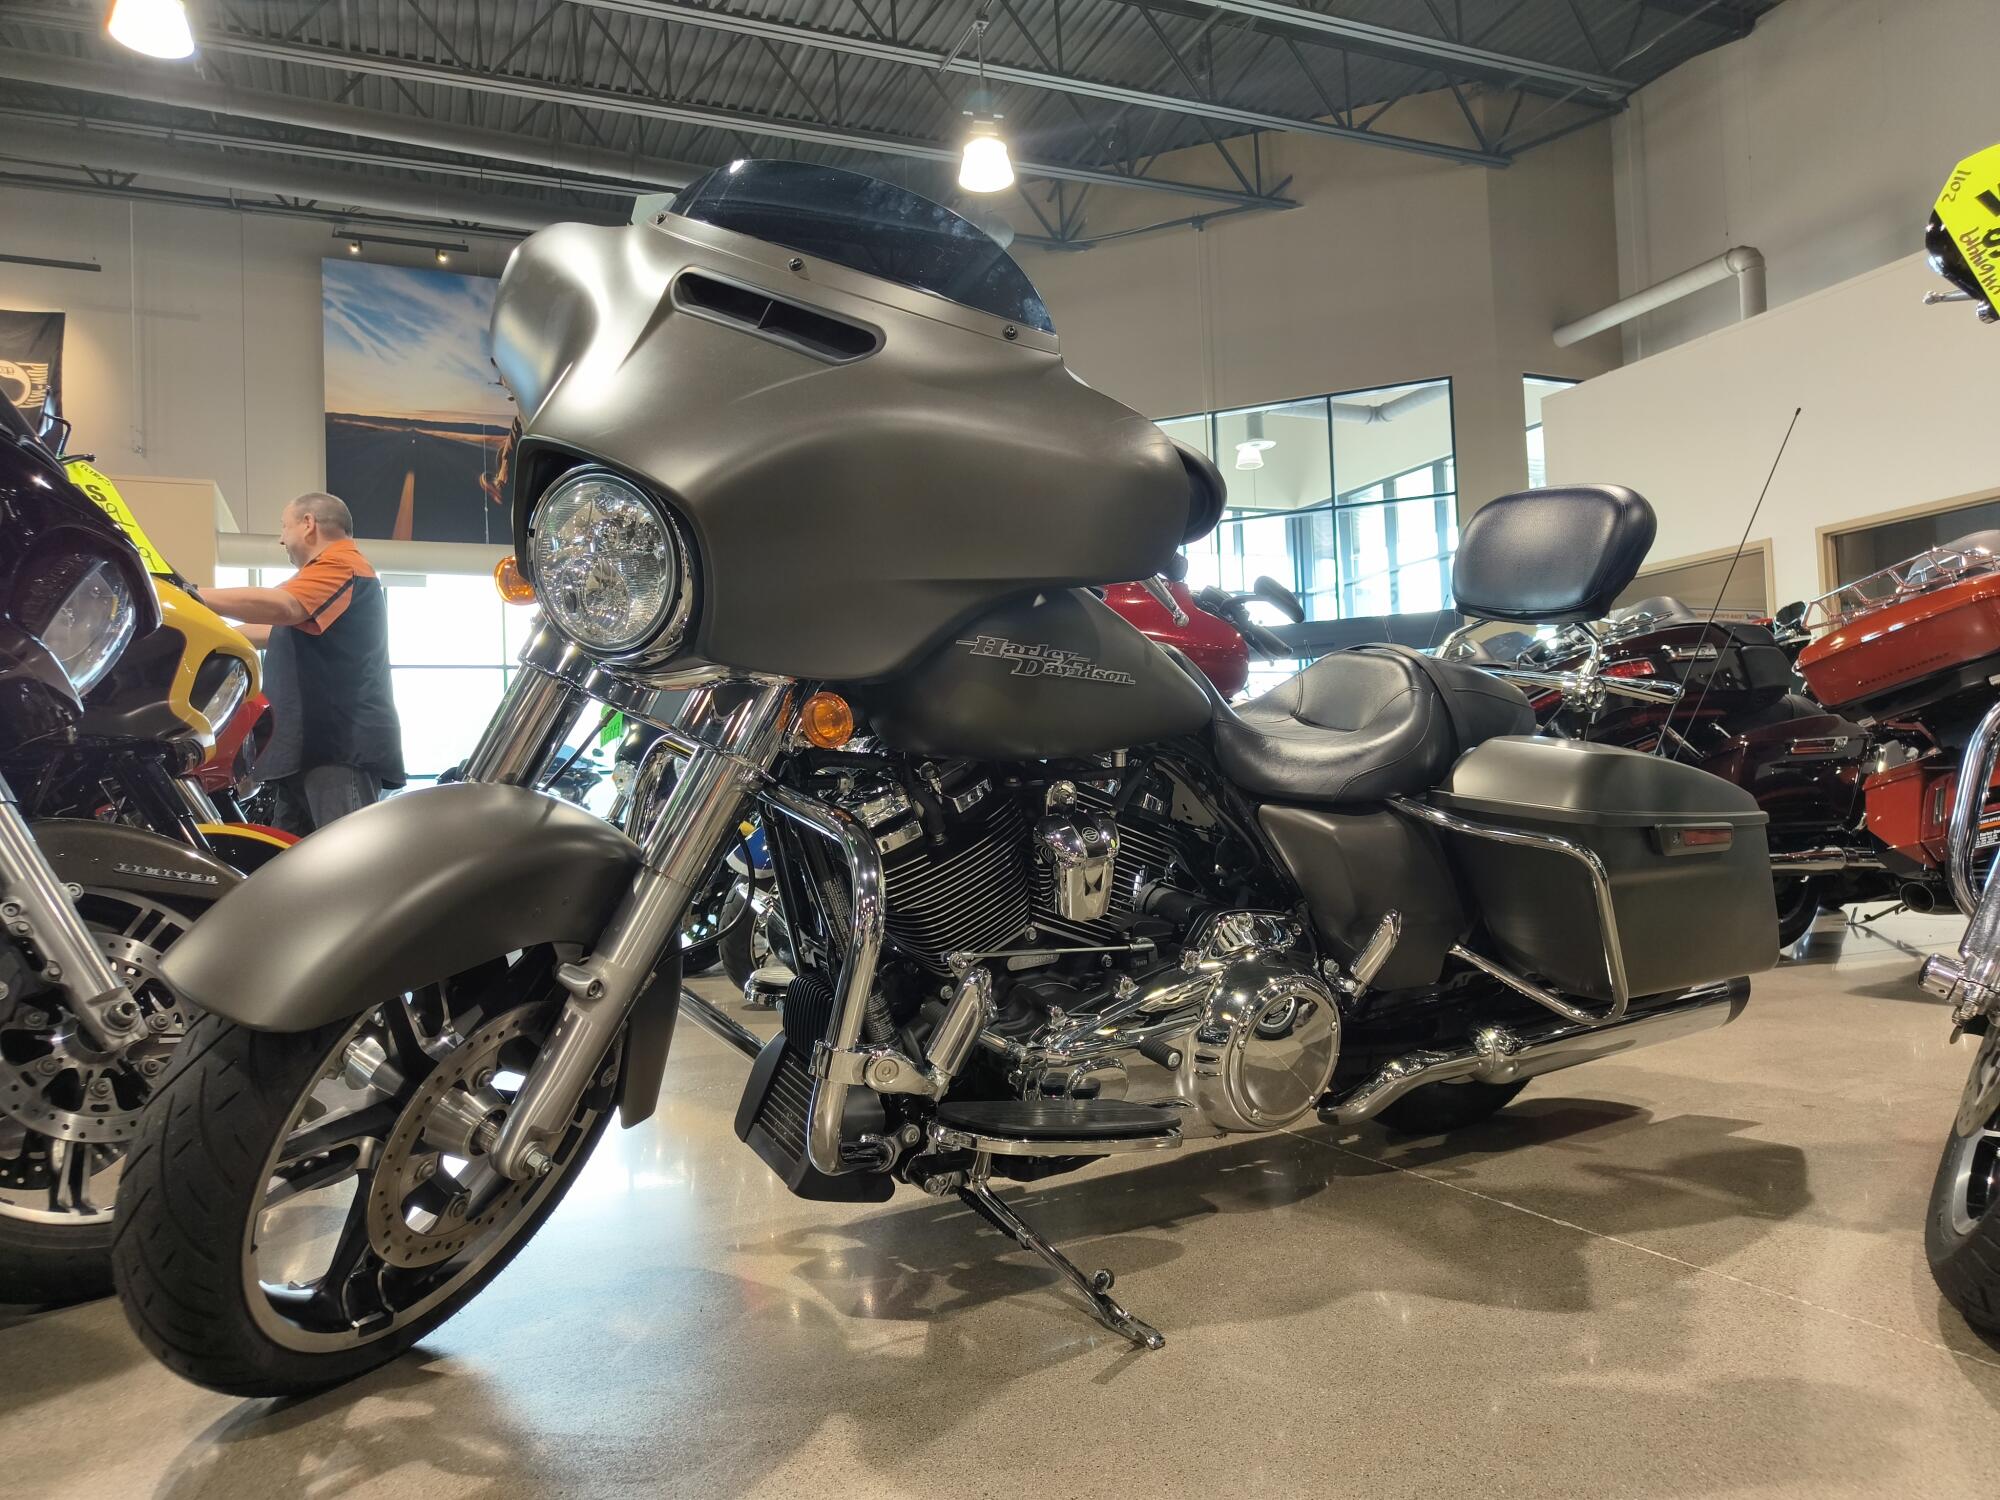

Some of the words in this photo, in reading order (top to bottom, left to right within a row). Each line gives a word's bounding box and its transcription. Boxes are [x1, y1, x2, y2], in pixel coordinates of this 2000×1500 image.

[1942, 169, 1971, 203] 2011
[1003, 656, 1136, 685] Davidson
[114, 862, 218, 884] LIMITED
